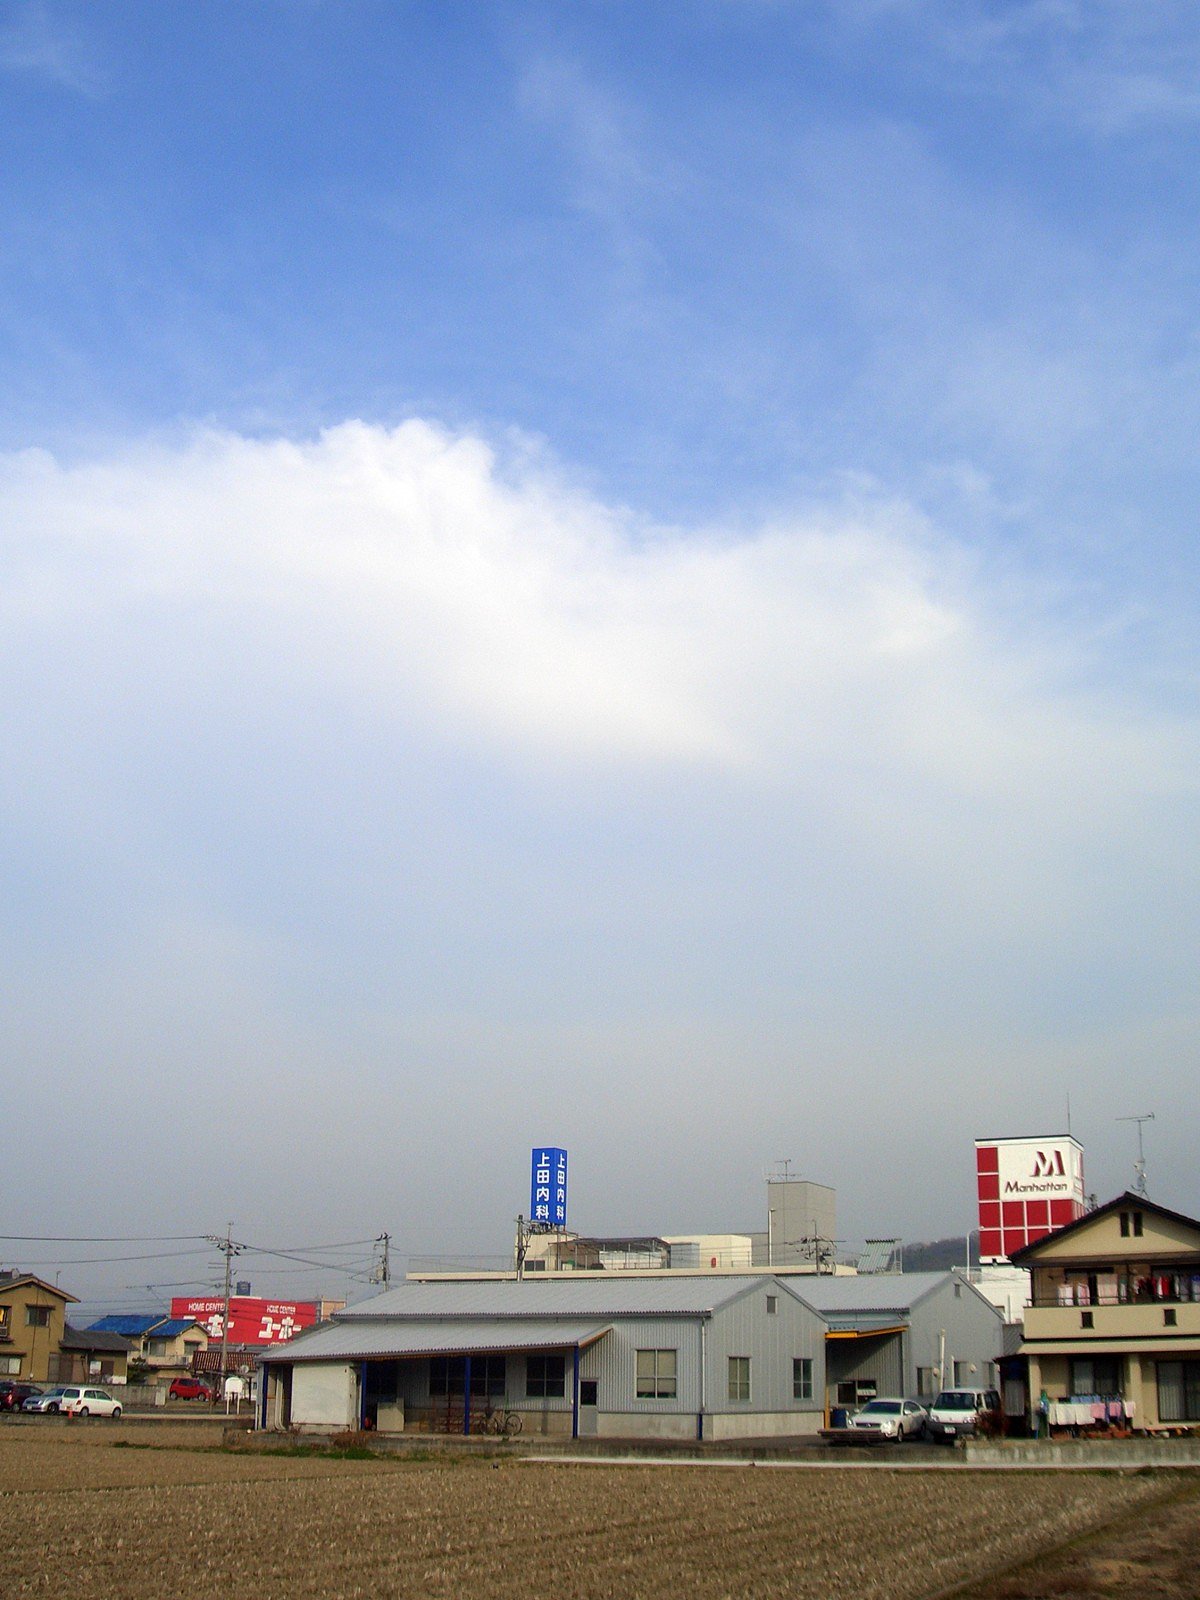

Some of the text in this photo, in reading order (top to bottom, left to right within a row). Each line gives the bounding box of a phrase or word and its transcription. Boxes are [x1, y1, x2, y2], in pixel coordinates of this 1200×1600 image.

[535, 1152, 550, 1219] 上田内科
[556, 1153, 565, 1220] 上田内科
[1005, 1181, 1068, 1193] Manhattan
[188, 1302, 205, 1312] HOME
[266, 1304, 279, 1314] HOME
